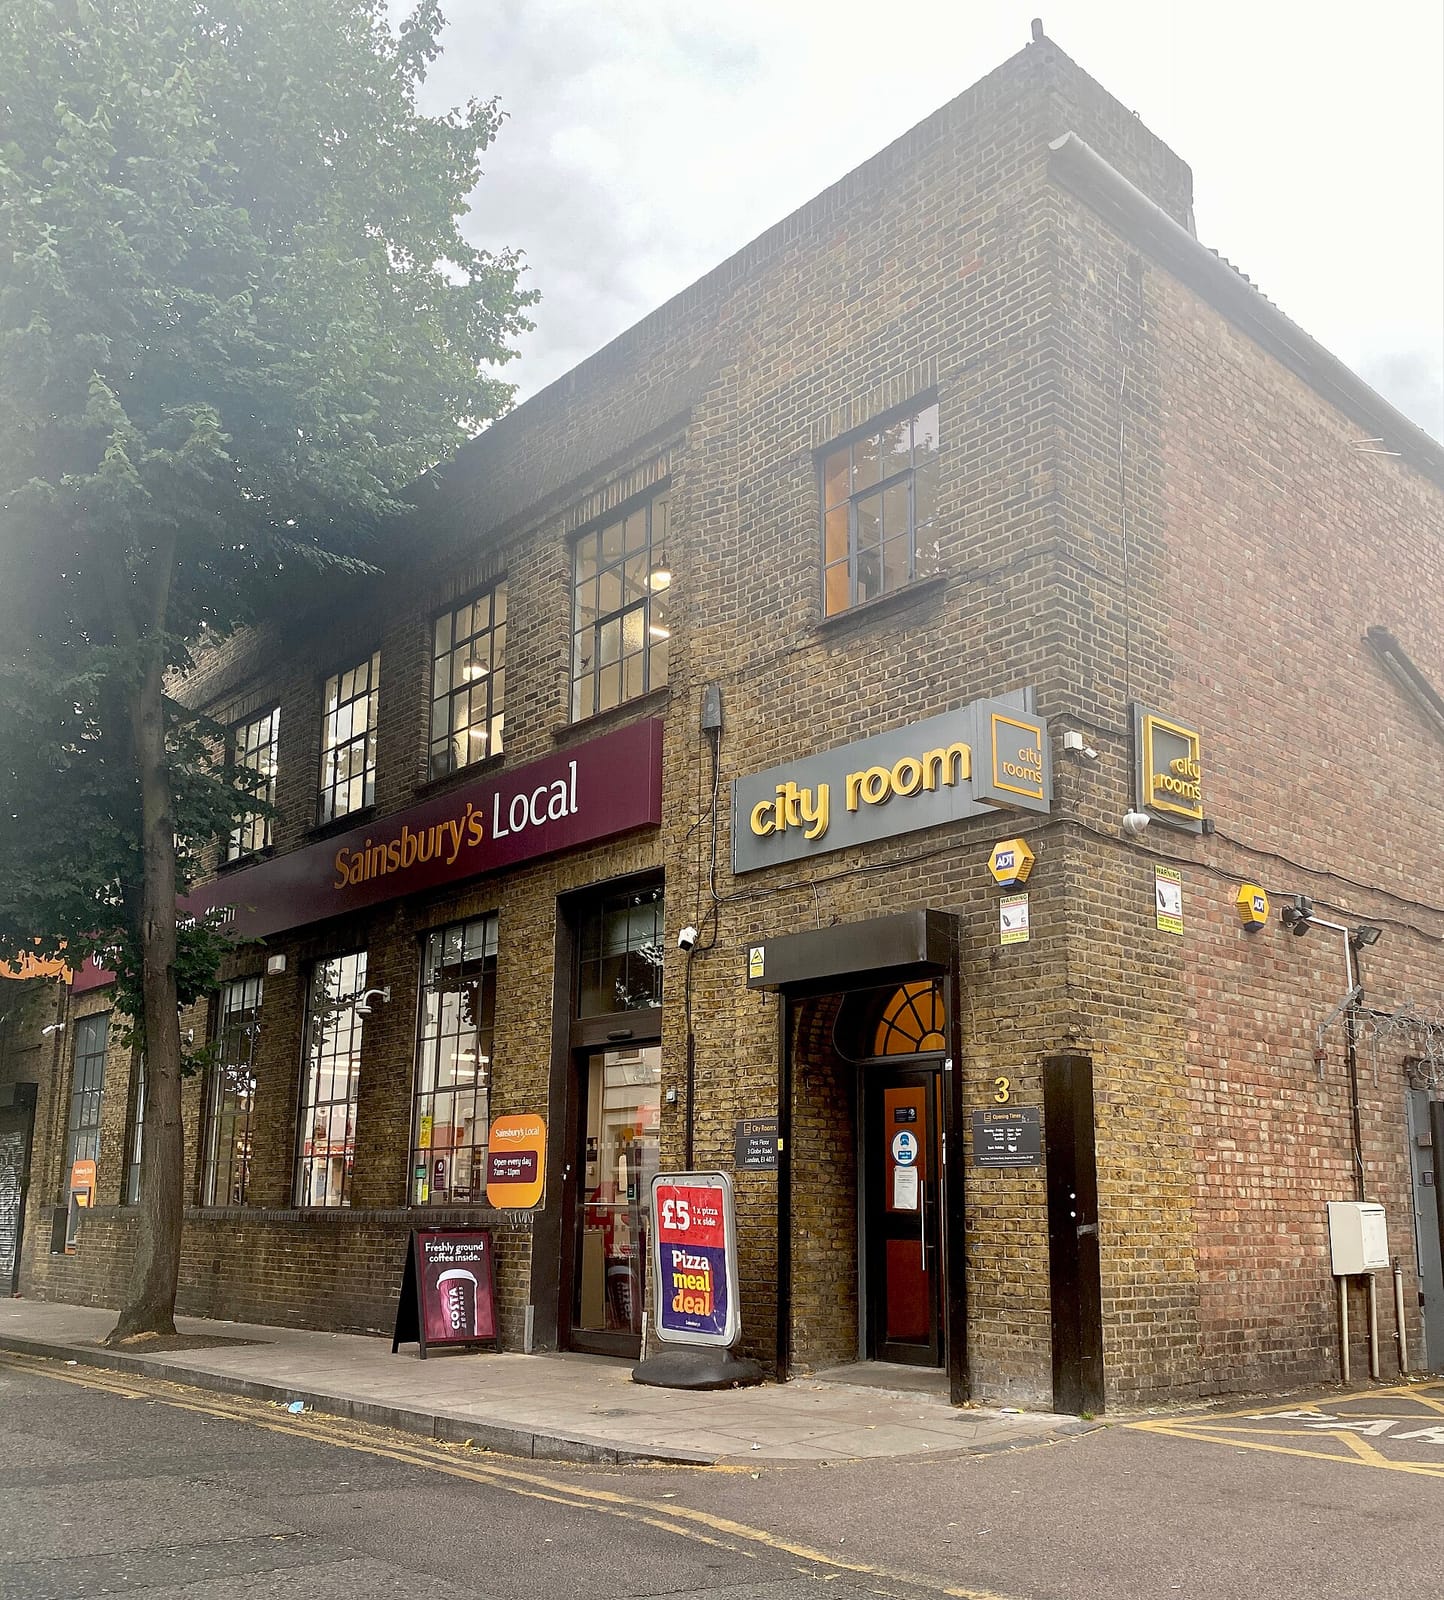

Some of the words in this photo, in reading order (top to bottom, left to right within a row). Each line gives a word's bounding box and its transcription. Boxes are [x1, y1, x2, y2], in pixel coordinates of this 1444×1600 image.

[1018, 747, 1042, 770] city
[1003, 761, 1042, 784] rooms
[1172, 757, 1200, 784] city
[1156, 773, 1201, 800] rooms
[750, 781, 829, 840] city
[333, 802, 484, 890] Sainsbury's
[492, 761, 578, 840] Local
[996, 853, 1014, 869] ADT
[1157, 867, 1180, 880] WARNING
[1001, 894, 1028, 904] WARNING
[1254, 897, 1264, 912] ADT
[994, 1076, 1010, 1103] 3
[495, 1128, 524, 1138] Sainsbury's
[525, 1126, 539, 1136] Local
[493, 1158, 506, 1168] Open
[507, 1159, 521, 1167] every
[522, 1157, 532, 1166] day
[493, 1168, 504, 1176] 7am
[661, 1199, 690, 1231] £5
[702, 1206, 718, 1217] pizza
[703, 1217, 716, 1226] side
[425, 1242, 454, 1255] Freshly
[455, 1241, 484, 1255] ground
[429, 1252, 454, 1262] coffee
[455, 1252, 481, 1262] inside.
[672, 1250, 710, 1270] Pizza
[672, 1271, 711, 1291] meal
[449, 1286, 460, 1330] COSTA
[672, 1289, 711, 1317] deal
